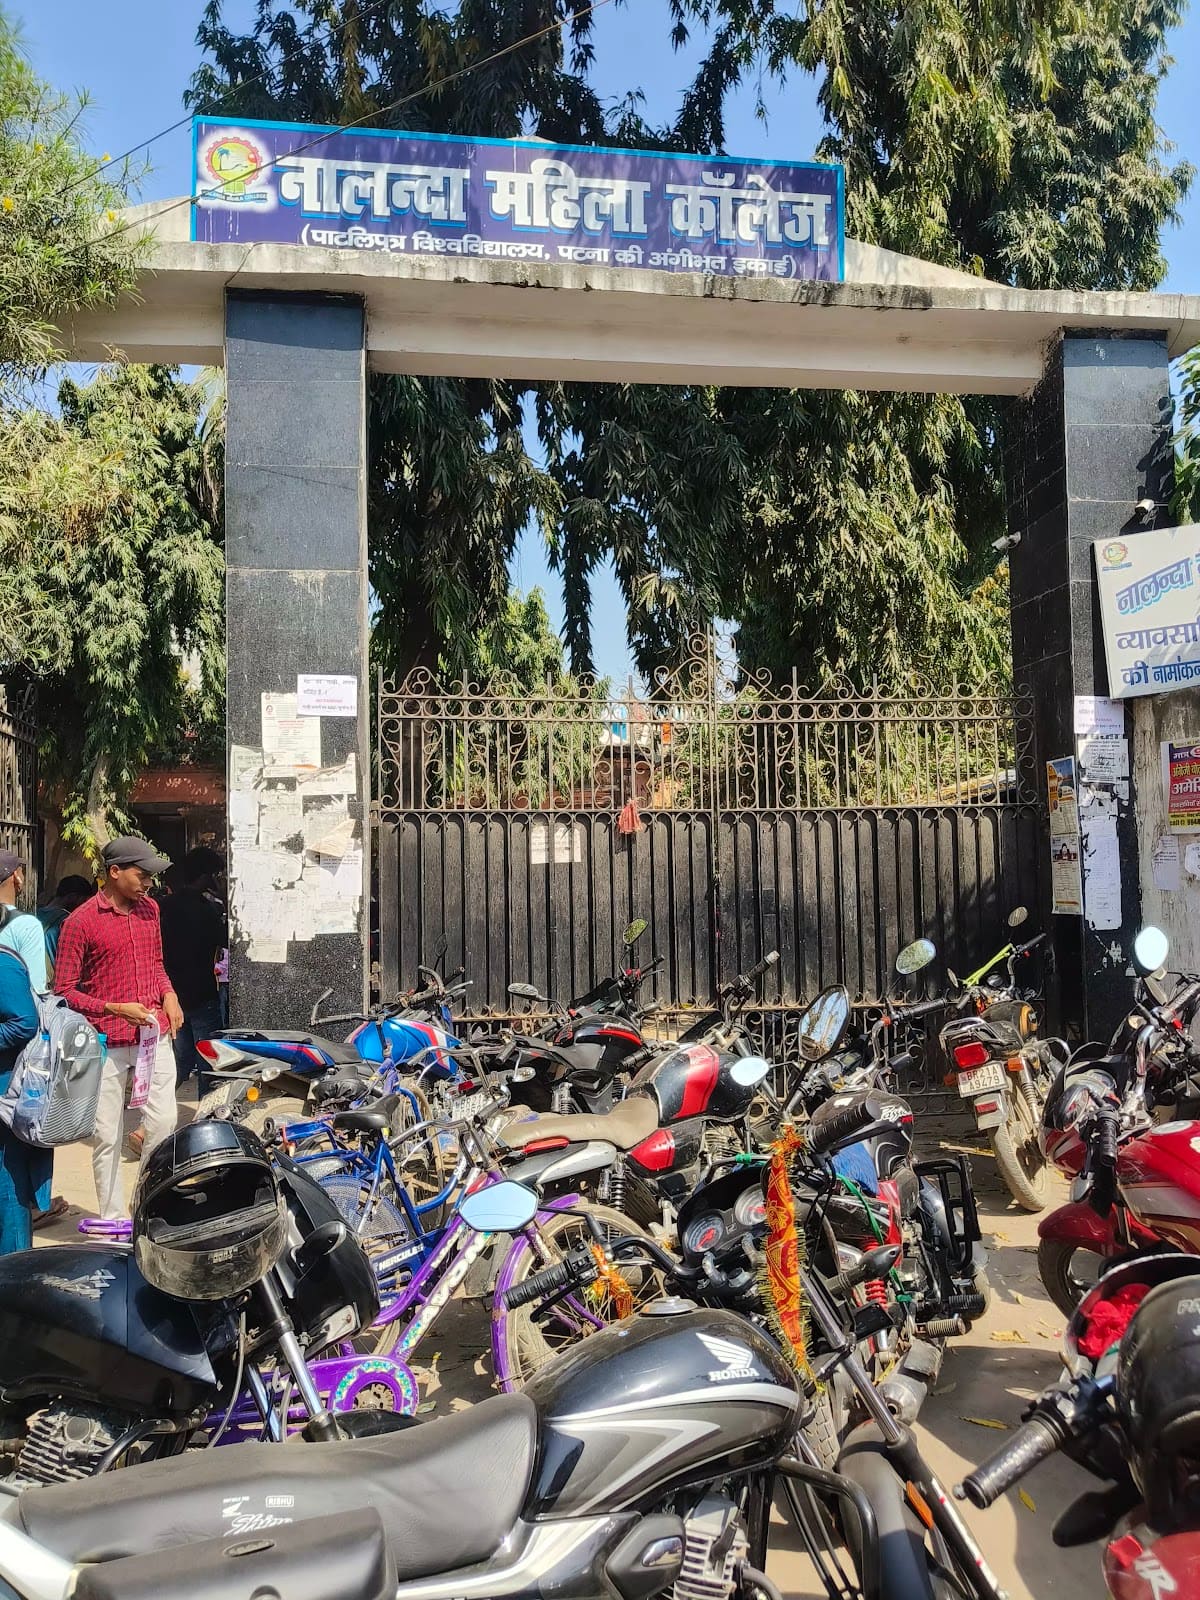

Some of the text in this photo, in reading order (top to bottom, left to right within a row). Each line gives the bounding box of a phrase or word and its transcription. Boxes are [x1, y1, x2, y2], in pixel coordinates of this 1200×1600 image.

[274, 155, 832, 248] नालन्दा महिला कॉलेज
[412, 231, 550, 260] विश्वविद्यालय,
[557, 244, 610, 263] पटना
[615, 244, 645, 265] की
[648, 248, 728, 281] अंगीभूत
[732, 253, 797, 279] इकाई)
[1115, 557, 1194, 615] नालन्दा
[1120, 660, 1149, 686] की
[378, 1243, 424, 1271] HERCULES
[708, 1367, 760, 1381] HONDA
